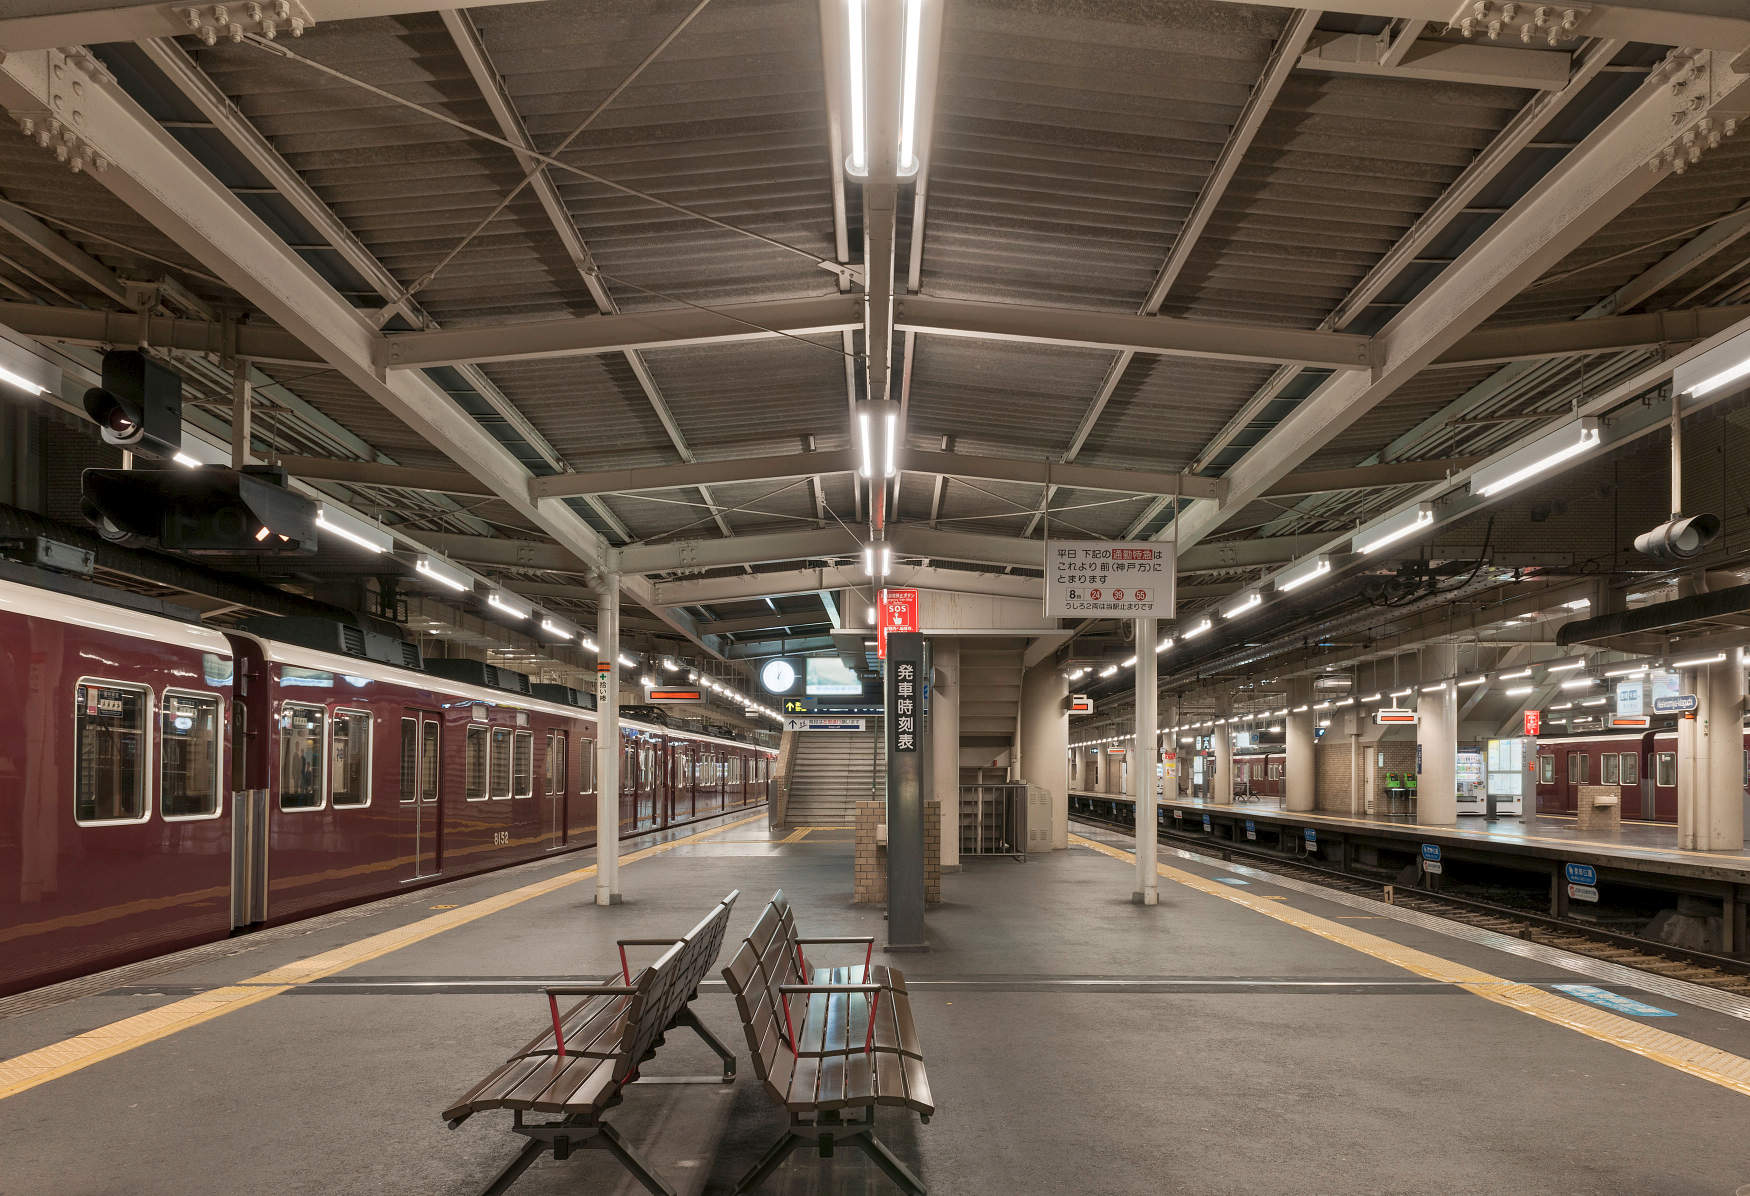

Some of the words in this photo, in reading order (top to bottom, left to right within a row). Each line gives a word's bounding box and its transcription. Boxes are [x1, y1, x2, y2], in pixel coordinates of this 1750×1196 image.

[1057, 549, 1077, 559] 平日
[1057, 574, 1108, 584] とまります
[1091, 590, 1101, 599] 24
[1114, 590, 1123, 599] 39
[1136, 591, 1145, 600] 55
[888, 605, 907, 613] SOS
[897, 663, 914, 750] 発車時刻表
[494, 831, 509, 846] 8152
